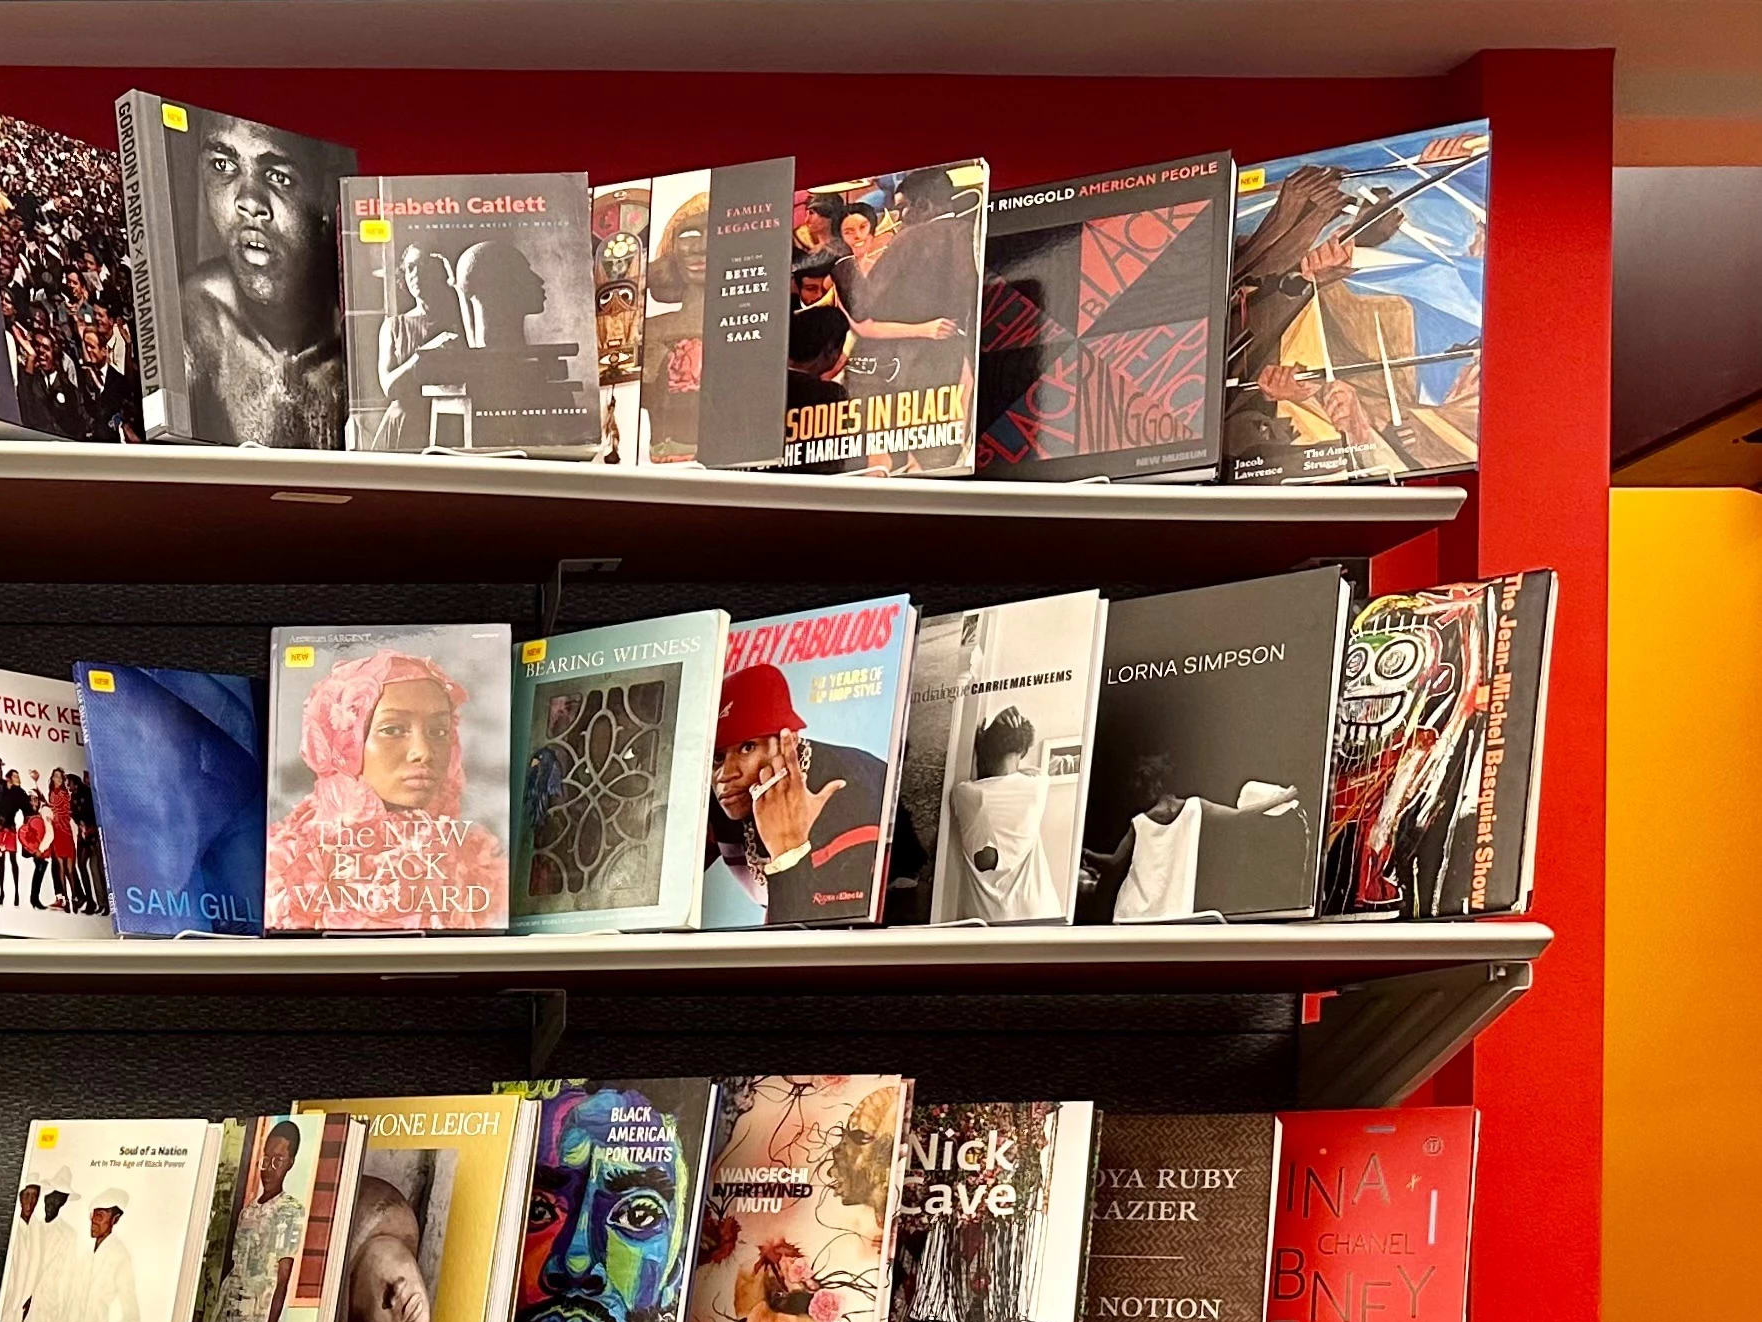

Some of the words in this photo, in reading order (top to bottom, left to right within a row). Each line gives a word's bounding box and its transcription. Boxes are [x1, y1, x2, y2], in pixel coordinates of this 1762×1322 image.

[118, 101, 137, 179] GORDON
[998, 188, 1076, 211] RINGGOLD
[1078, 173, 1157, 198] AMERICAN
[1160, 161, 1219, 183] PEOPLE
[127, 180, 145, 245] PARKS
[355, 197, 460, 216] Elizabeth
[467, 196, 546, 213] Catlett
[725, 202, 773, 218] FAMILY
[717, 218, 780, 236] LEGACIES
[134, 261, 157, 380] MUHAMMAD
[720, 312, 769, 327] ALISON
[726, 330, 761, 342] SAAR
[867, 394, 892, 431] IN
[895, 384, 965, 426] BLACK
[805, 434, 862, 464] HARLEM
[865, 421, 964, 456] RENAISSANCE
[1326, 443, 1378, 457] American
[1162, 449, 1208, 464] MUSEUM
[1234, 457, 1264, 470] Jacob
[1234, 466, 1284, 480] Lawrence
[1501, 571, 1523, 611] The
[779, 603, 900, 664] FABULOUS
[525, 652, 605, 679] BEARING
[614, 636, 701, 663] WITNESS
[1107, 659, 1177, 685] LORNA
[1183, 643, 1285, 675] SIMPSON
[970, 679, 1009, 695] CARRIE
[1009, 675, 1032, 689] MAE
[1033, 670, 1073, 686] WEEMS
[1488, 614, 1520, 746] Jean-Michel
[48, 727, 70, 743] OF
[1478, 747, 1504, 843] Basquiat
[315, 822, 375, 849] The
[382, 821, 474, 848] NEW
[333, 853, 449, 880] BLACK
[1470, 846, 1494, 909] Show
[126, 886, 191, 918] SAM
[293, 885, 491, 914] VANGUARD
[430, 1112, 501, 1136] LEIGH
[610, 1107, 652, 1123] BLACK
[606, 1126, 676, 1143] AMERICAN
[119, 1146, 139, 1156] Soul
[158, 1146, 188, 1156] Nation
[605, 1146, 673, 1163] PORTRAITS
[904, 1128, 1016, 1172] Nick
[720, 1167, 809, 1185] WANGECHI
[1157, 1169, 1241, 1190] RUBY
[712, 1183, 813, 1198] INTERTWINED
[899, 1177, 1017, 1217] Cave
[736, 1198, 783, 1214] MUTU
[1317, 1232, 1416, 1256] CHANEL
[1099, 1297, 1223, 1321] NOTION
